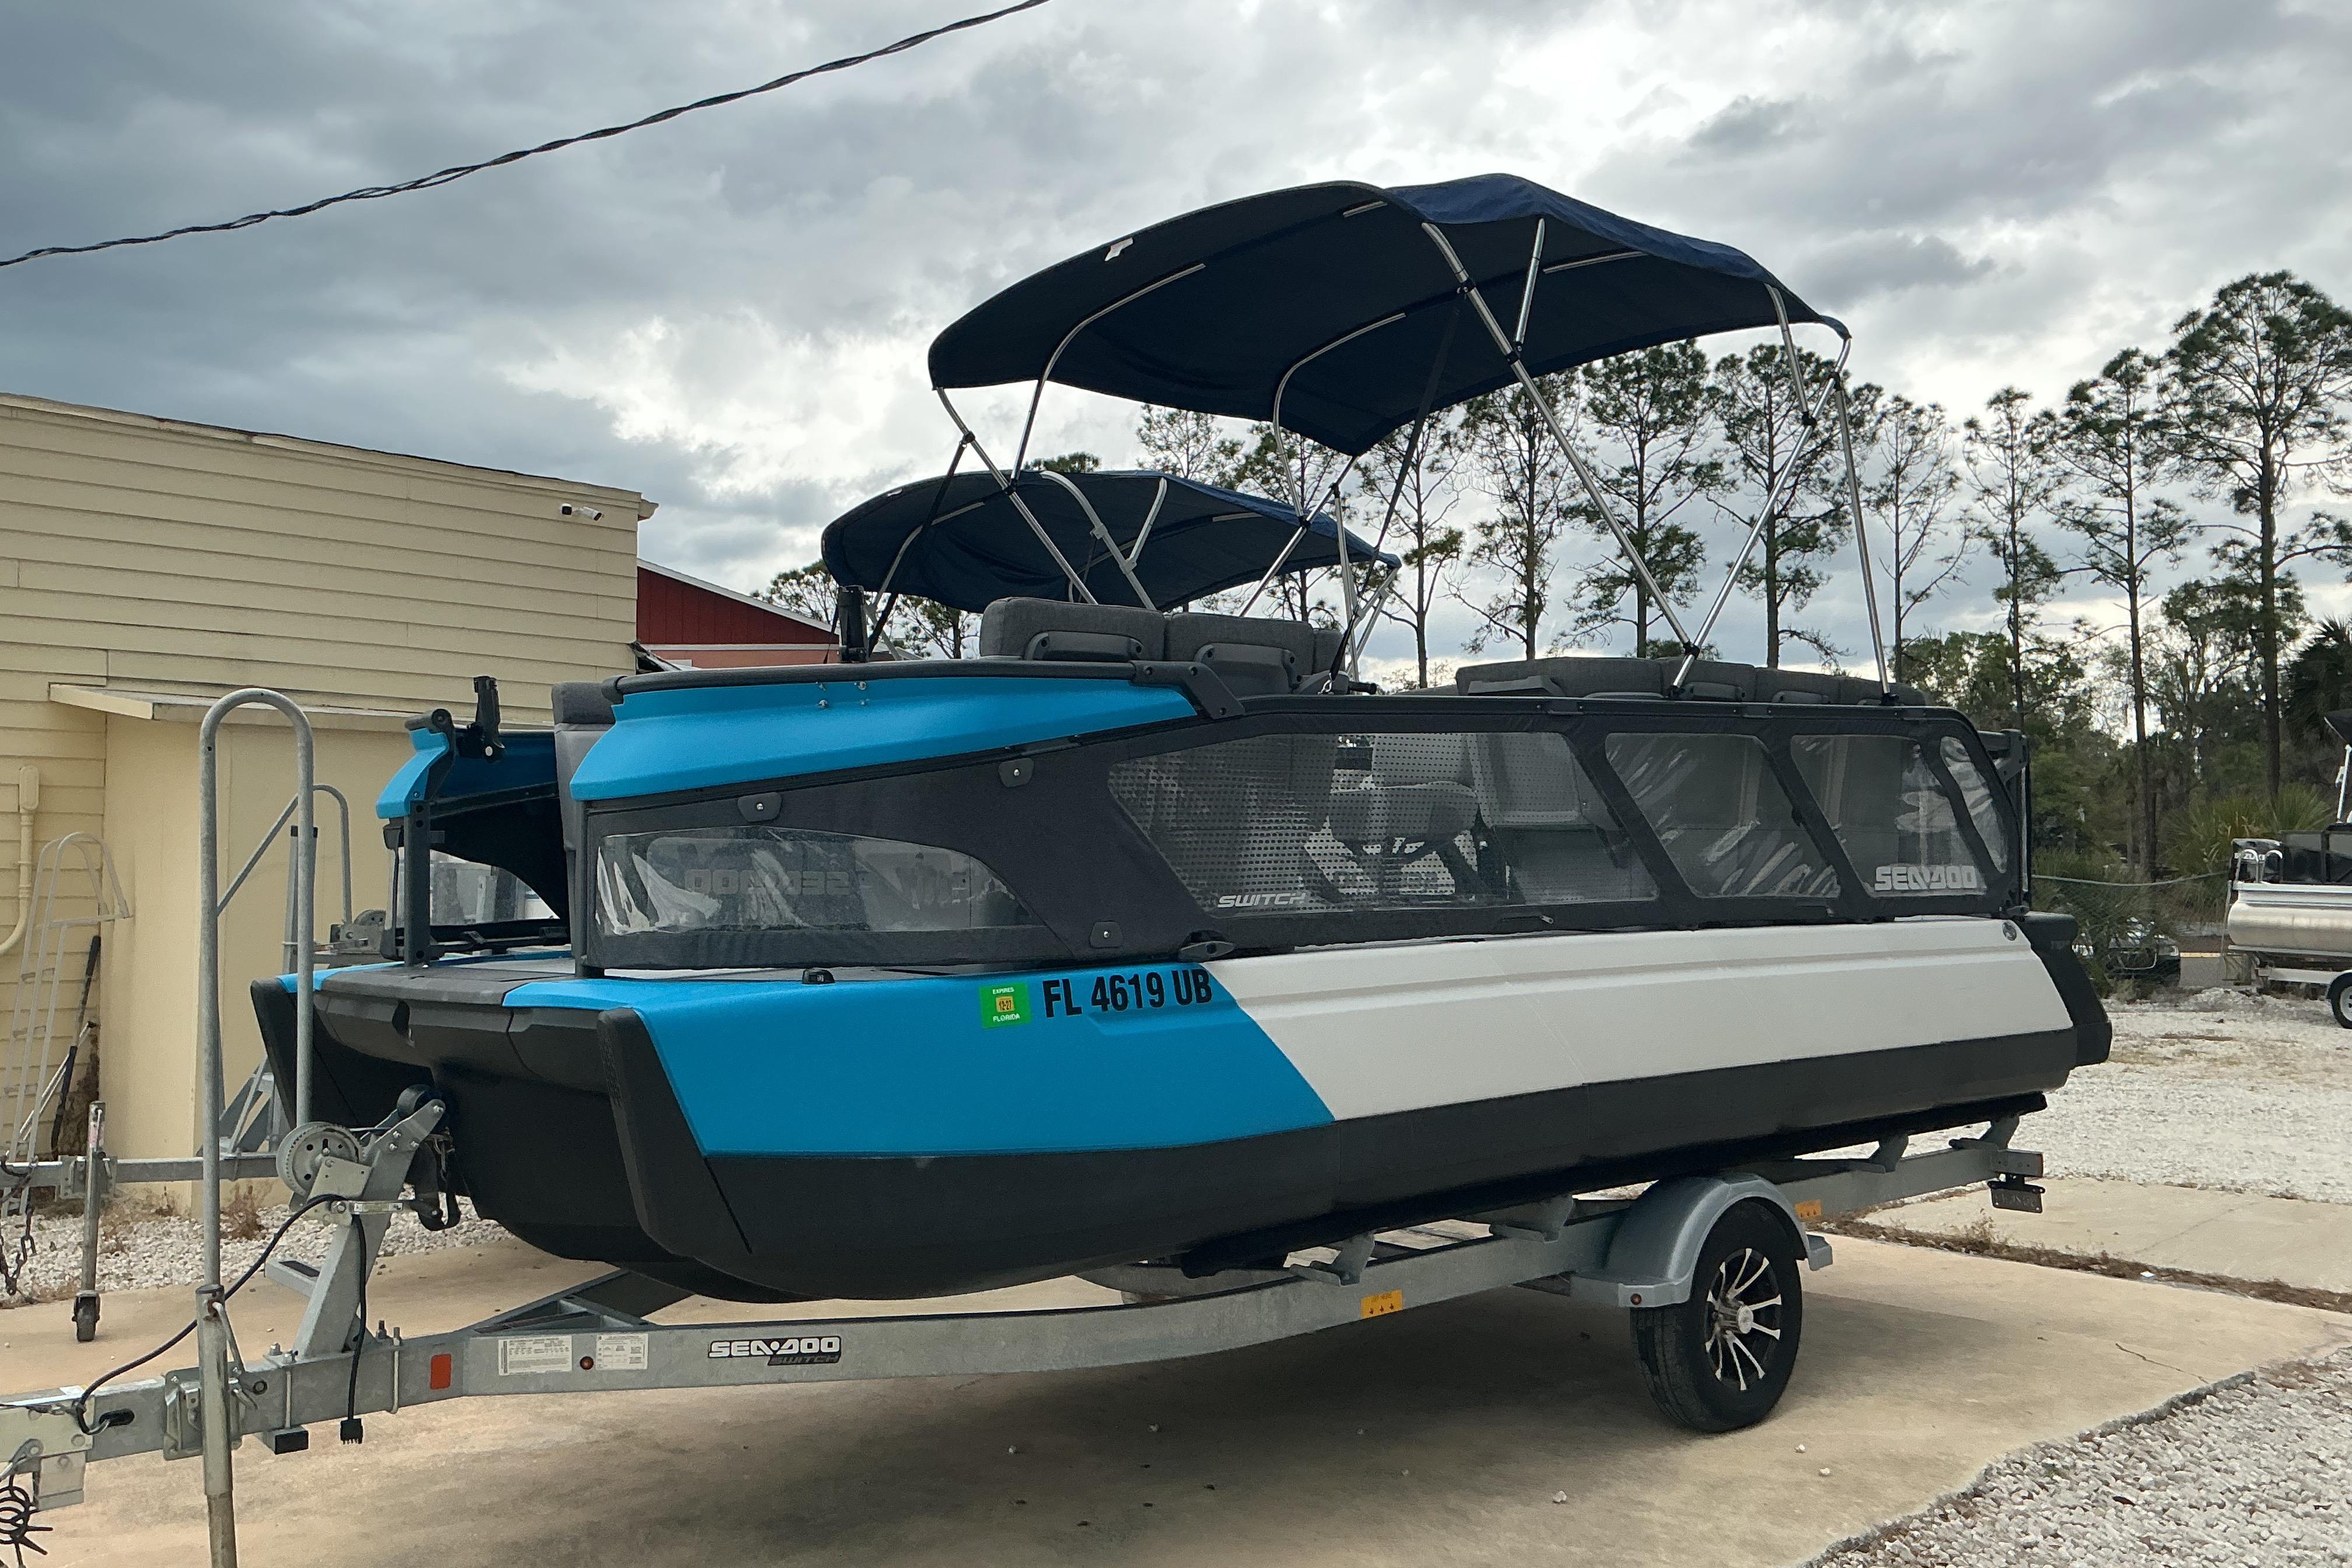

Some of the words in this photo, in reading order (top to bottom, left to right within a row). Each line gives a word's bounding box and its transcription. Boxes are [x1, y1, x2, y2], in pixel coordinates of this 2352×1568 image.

[1217, 892, 1306, 908] SWITCH
[1042, 973, 1082, 1018] FL
[1091, 972, 1166, 1012] 4619
[1171, 968, 1212, 1006] UB
[993, 1013, 1020, 1022] FLORIDA
[770, 1354, 838, 1364] SWITCH
